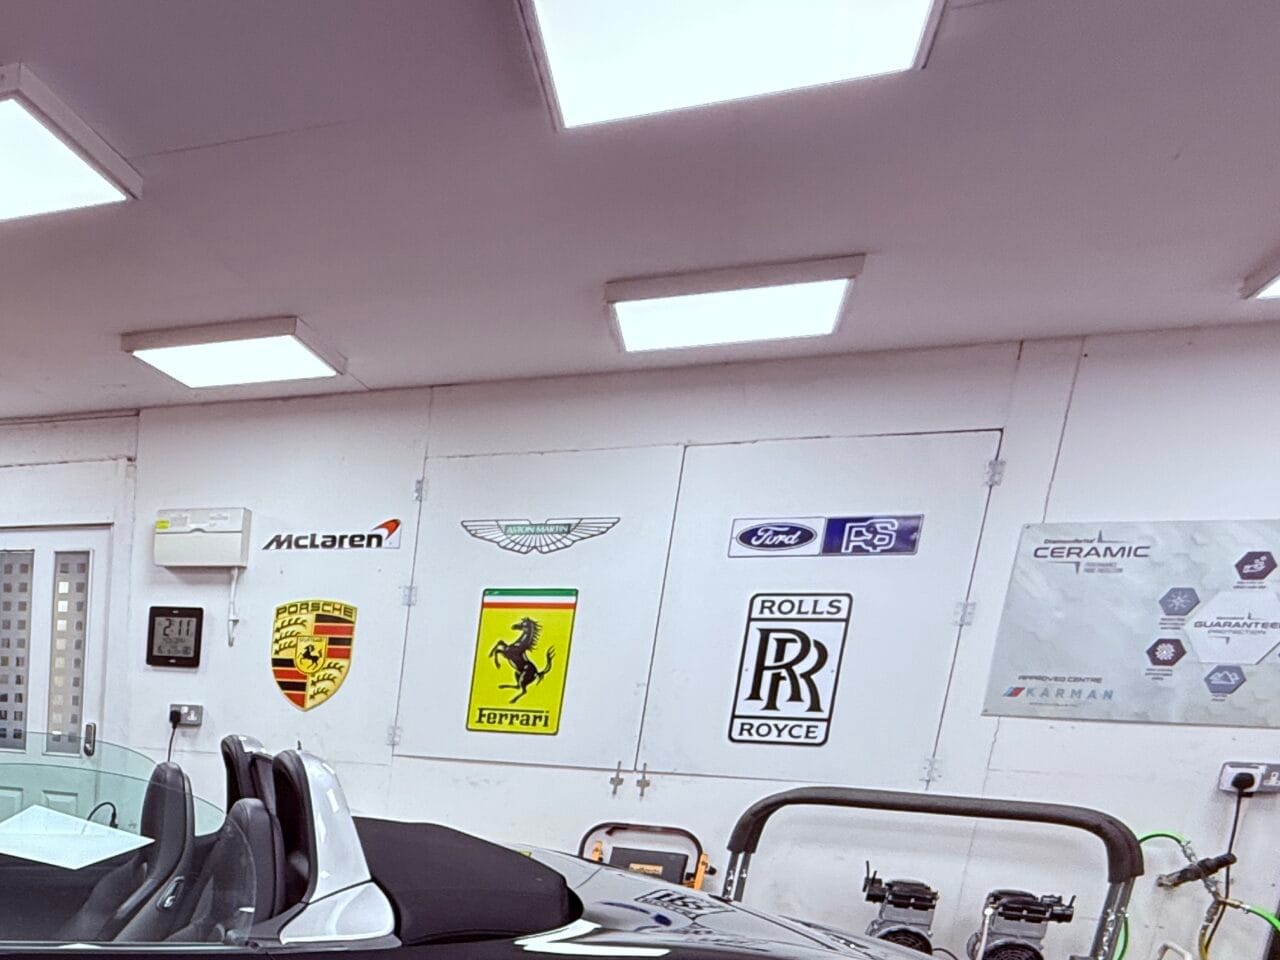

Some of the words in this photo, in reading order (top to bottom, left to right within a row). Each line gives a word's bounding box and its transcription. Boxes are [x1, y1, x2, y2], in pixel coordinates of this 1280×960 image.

[507, 525, 534, 535] ASTON
[536, 525, 568, 534] MARTIN
[751, 526, 801, 546] Ford
[841, 519, 899, 553] RS
[262, 533, 384, 551] McLaren
[1033, 546, 1151, 559] CERAMIC
[276, 602, 355, 619] PORSCHE
[759, 599, 842, 615] ROLLS
[1194, 620, 1280, 630] GUARANTEE
[744, 627, 828, 712] RR
[1067, 676, 1103, 684] CENTRE
[1026, 687, 1114, 700] KARMAN
[475, 707, 550, 727] Ferrari
[738, 722, 819, 740] ROYCE
